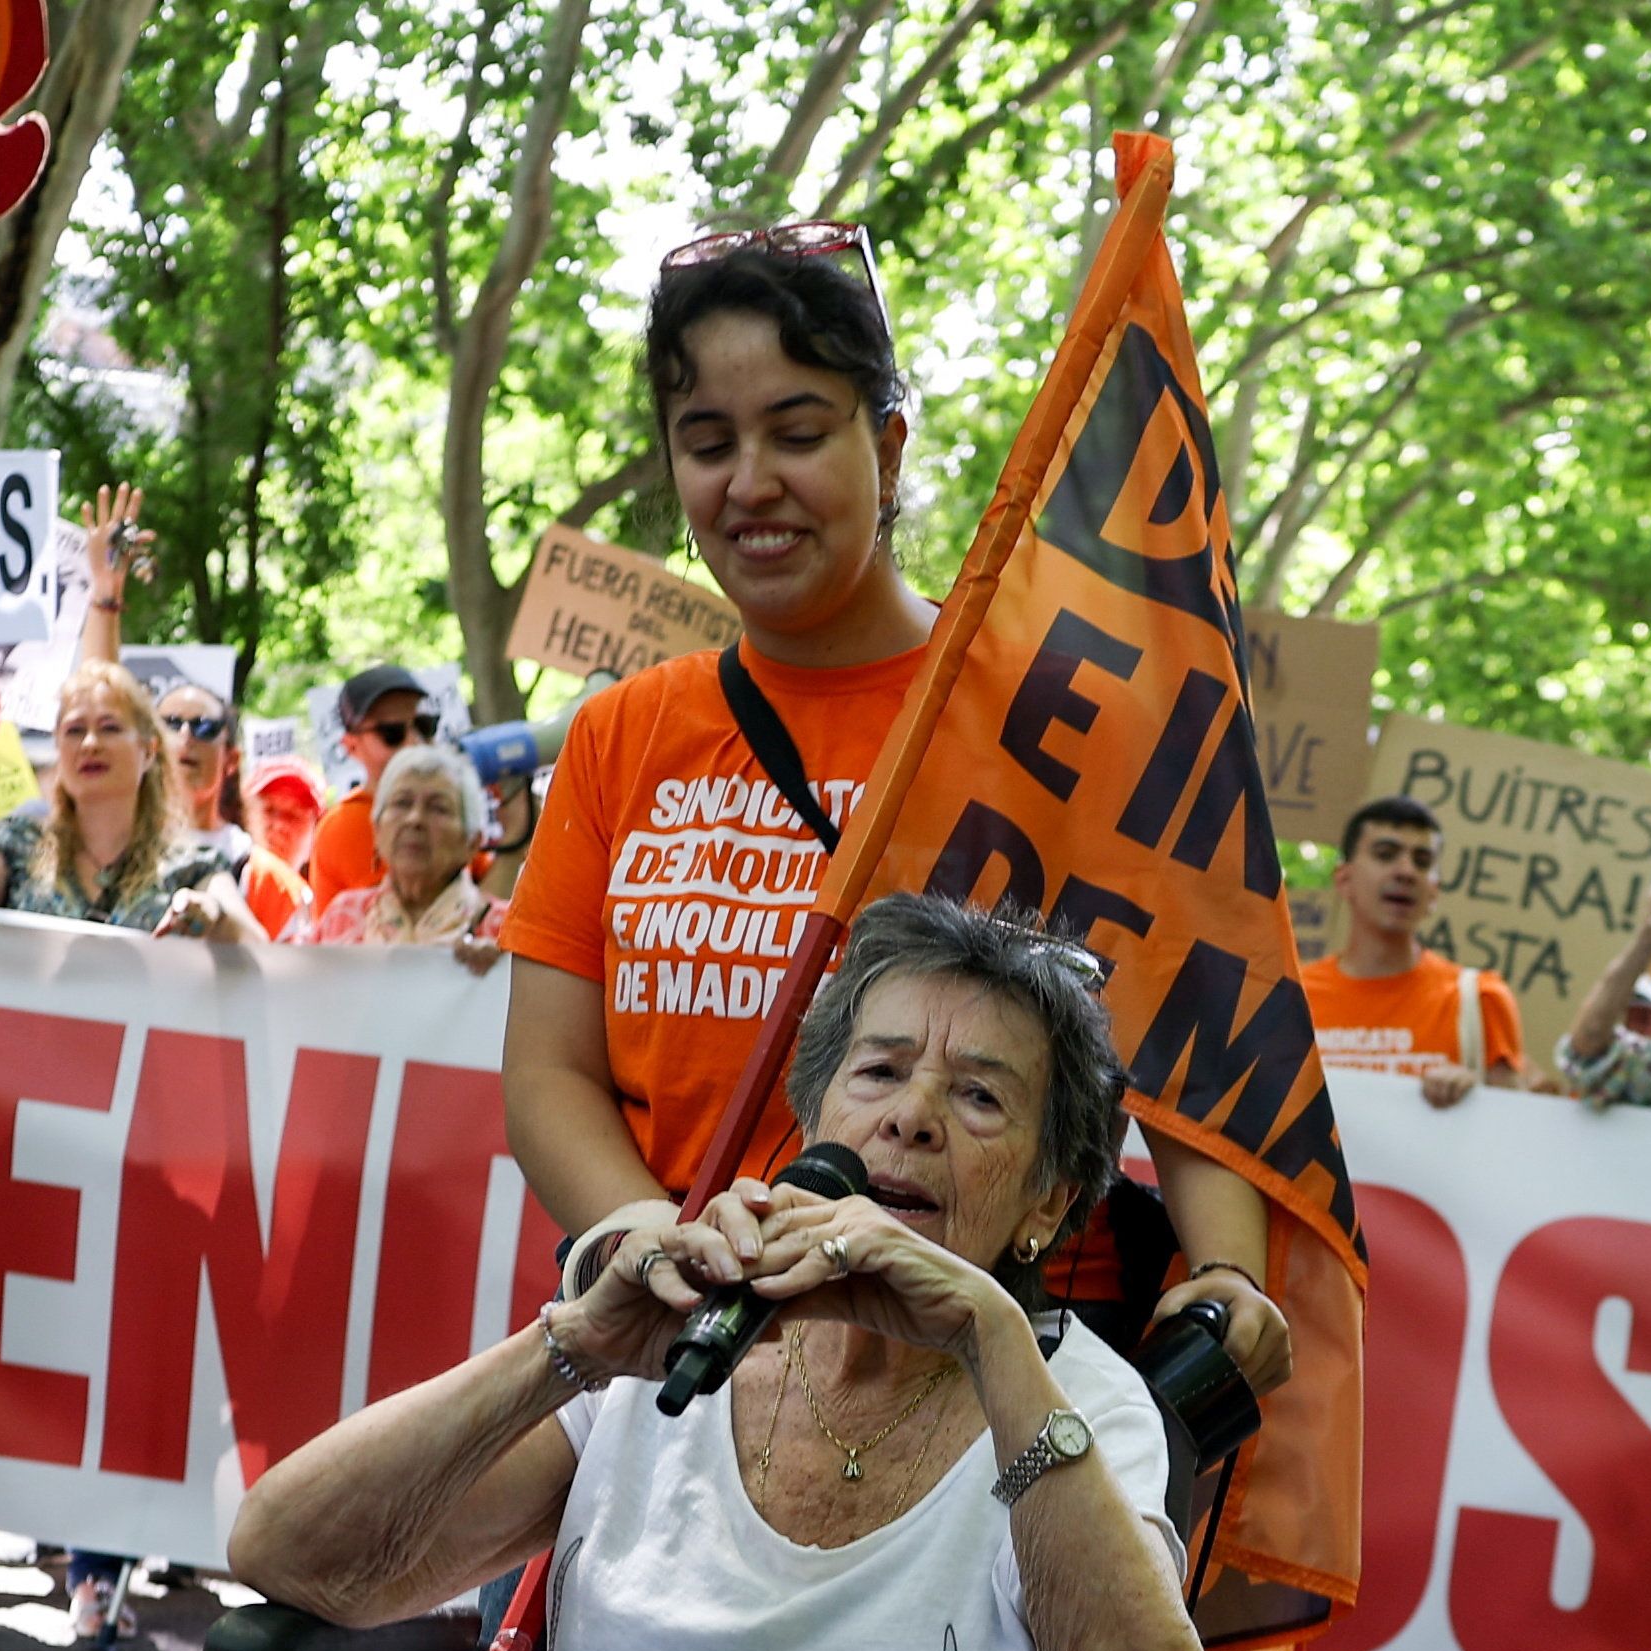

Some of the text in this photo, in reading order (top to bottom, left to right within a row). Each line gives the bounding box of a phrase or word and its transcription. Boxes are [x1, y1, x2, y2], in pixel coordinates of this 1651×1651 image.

[543, 541, 744, 645] FUERA RENTIST
[625, 842, 681, 885] DE
[611, 901, 638, 950] E
[614, 960, 650, 1014] DE
